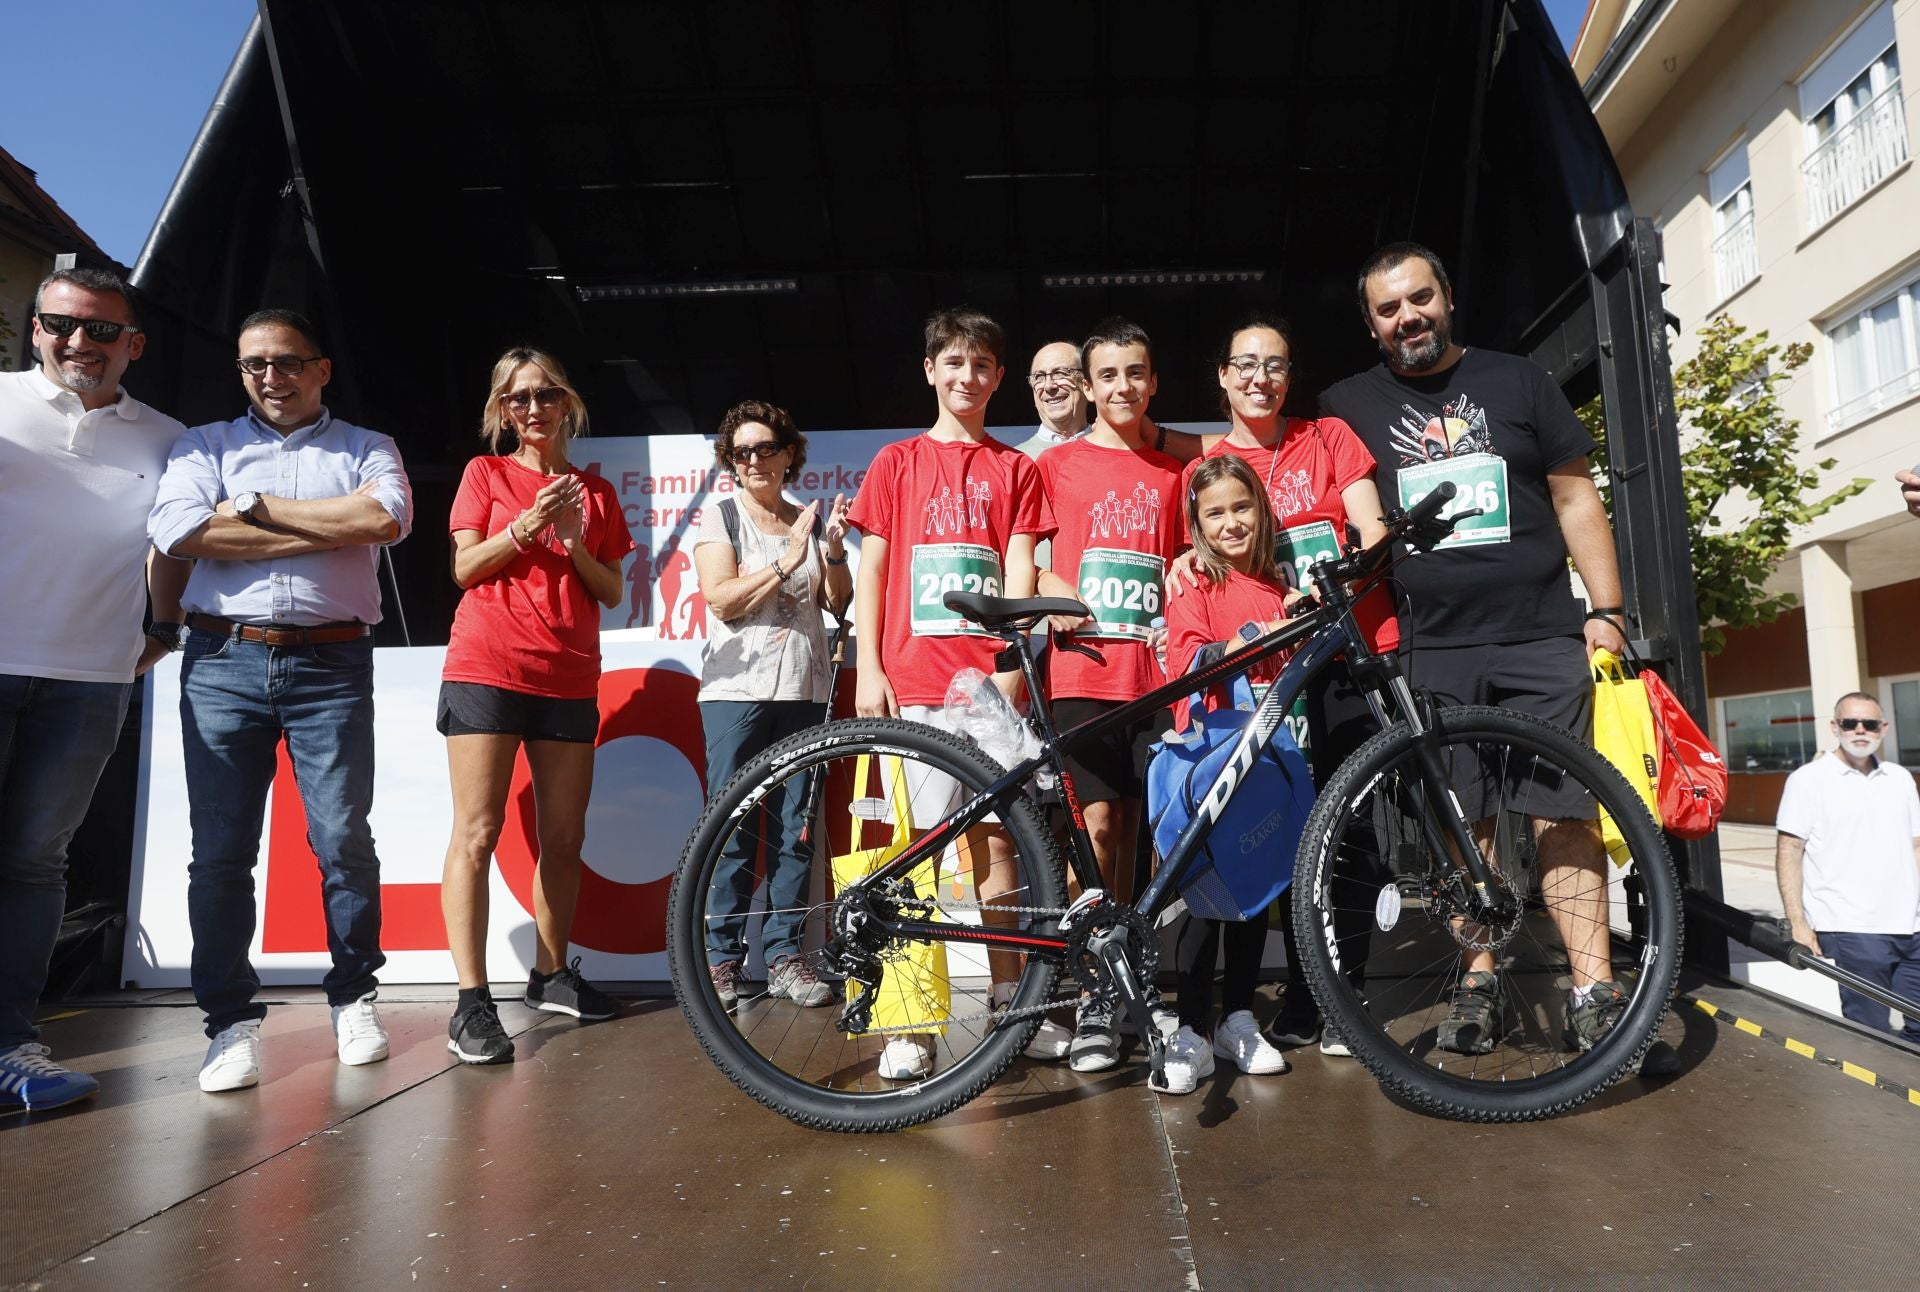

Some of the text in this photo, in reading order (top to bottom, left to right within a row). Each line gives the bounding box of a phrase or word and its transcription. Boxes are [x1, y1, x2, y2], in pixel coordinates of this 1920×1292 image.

[621, 468, 734, 496] Familia
[624, 503, 703, 529] Carre
[1082, 576, 1159, 613] 2026
[1061, 772, 1086, 830] TRACKER
